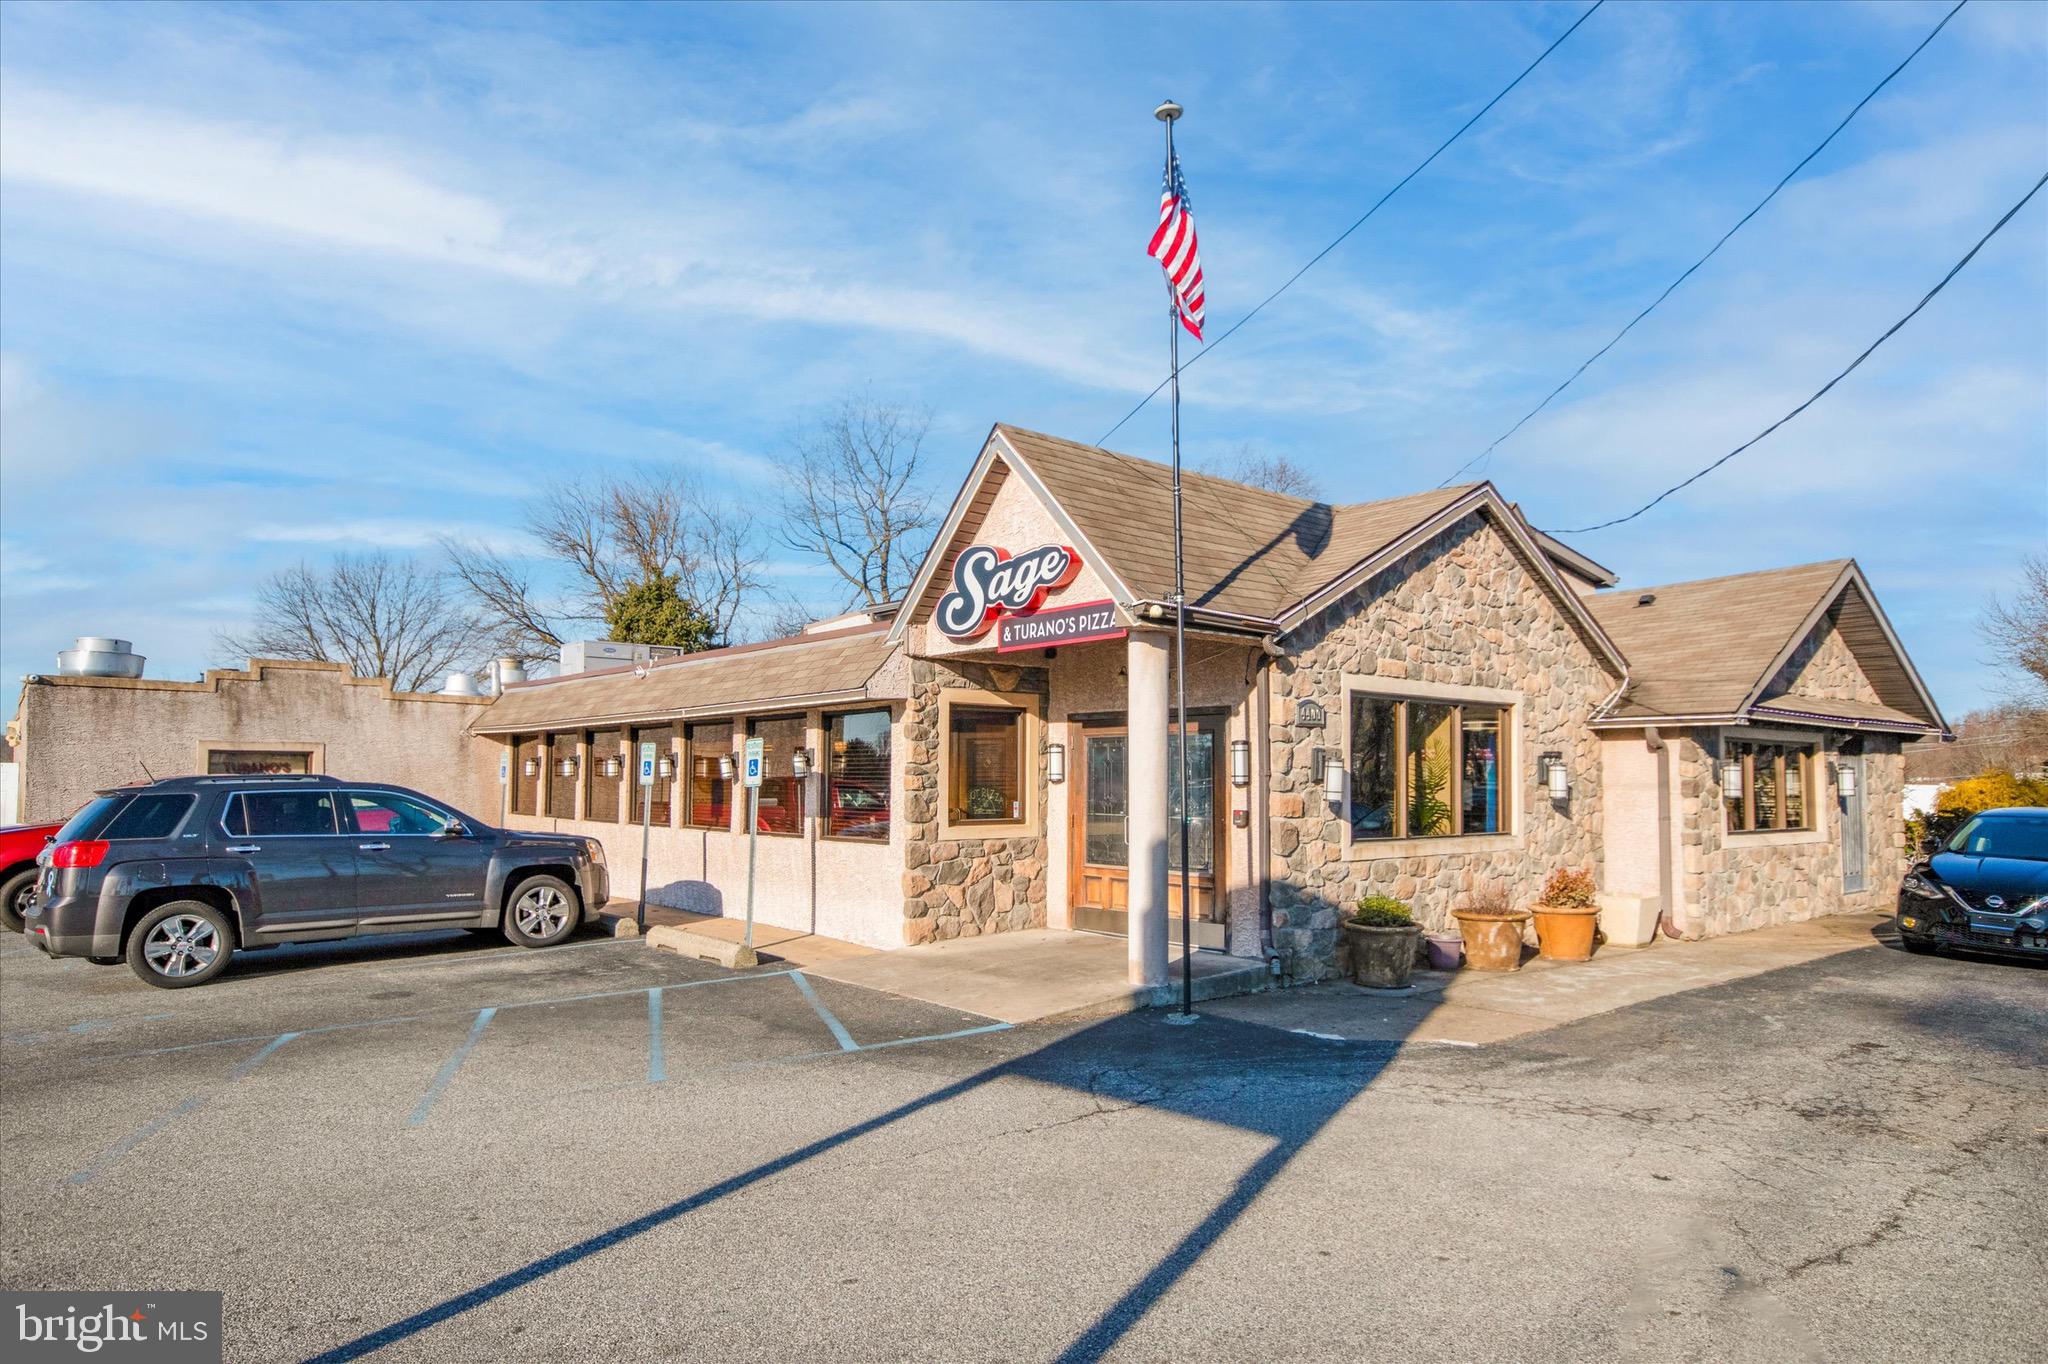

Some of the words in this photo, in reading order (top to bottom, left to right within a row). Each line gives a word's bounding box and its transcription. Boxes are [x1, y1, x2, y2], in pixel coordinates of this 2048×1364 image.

[945, 551, 1065, 631] Sage
[1003, 626, 1012, 642] &
[1014, 616, 1076, 641] TURANO'S
